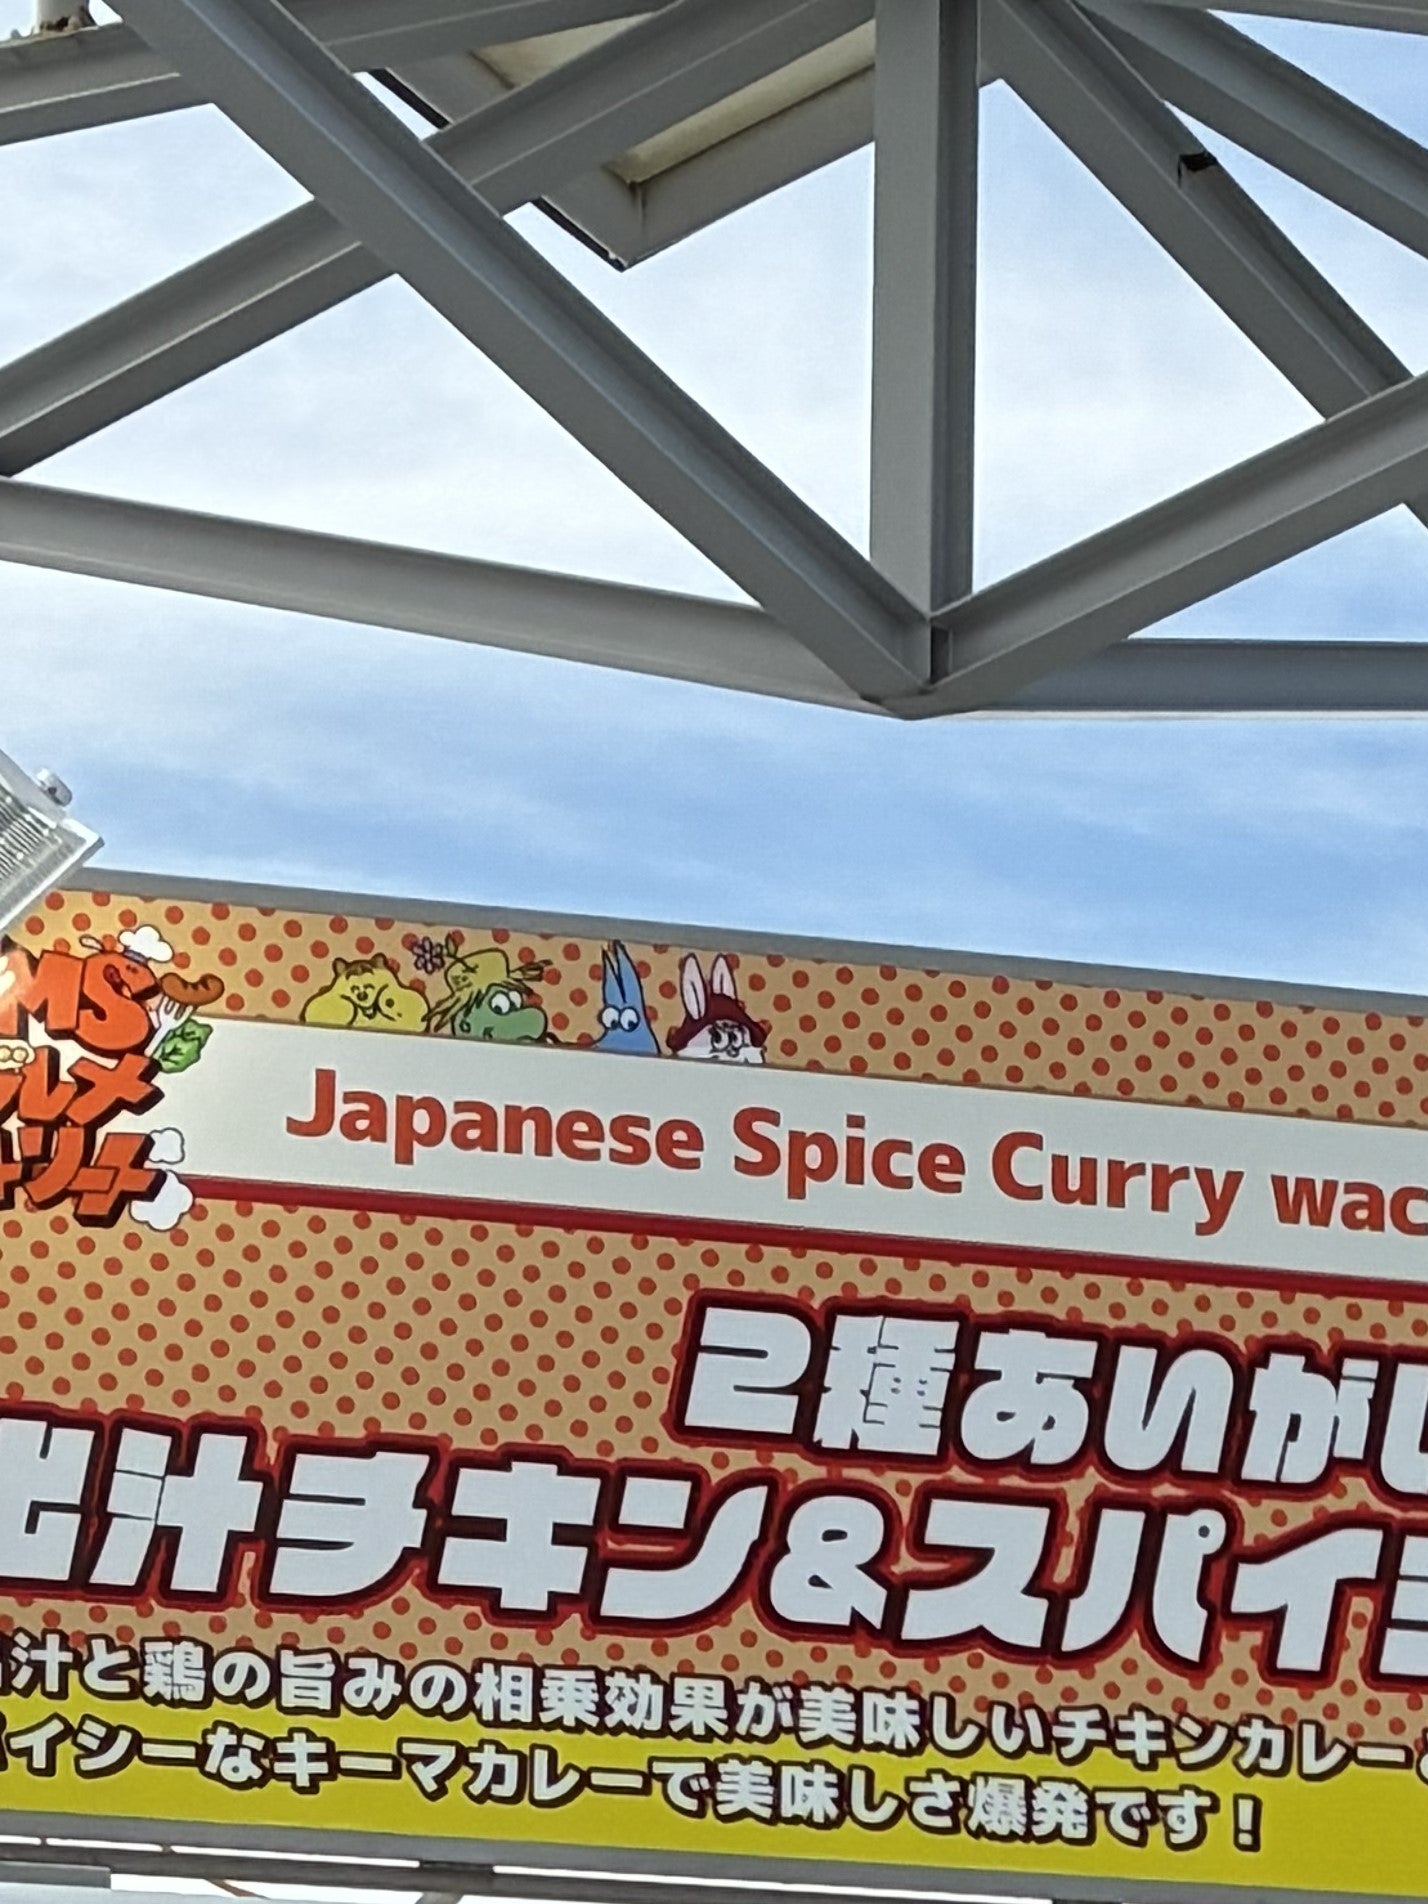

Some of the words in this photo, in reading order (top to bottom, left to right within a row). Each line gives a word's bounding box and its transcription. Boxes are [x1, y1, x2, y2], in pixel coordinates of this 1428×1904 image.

[287, 1068, 704, 1171] Japanese
[733, 1105, 967, 1200] Spice
[991, 1131, 1245, 1236] Curry
[0, 1715, 1264, 1850] イシーなキーマカレーで美味しさ爆発です！
